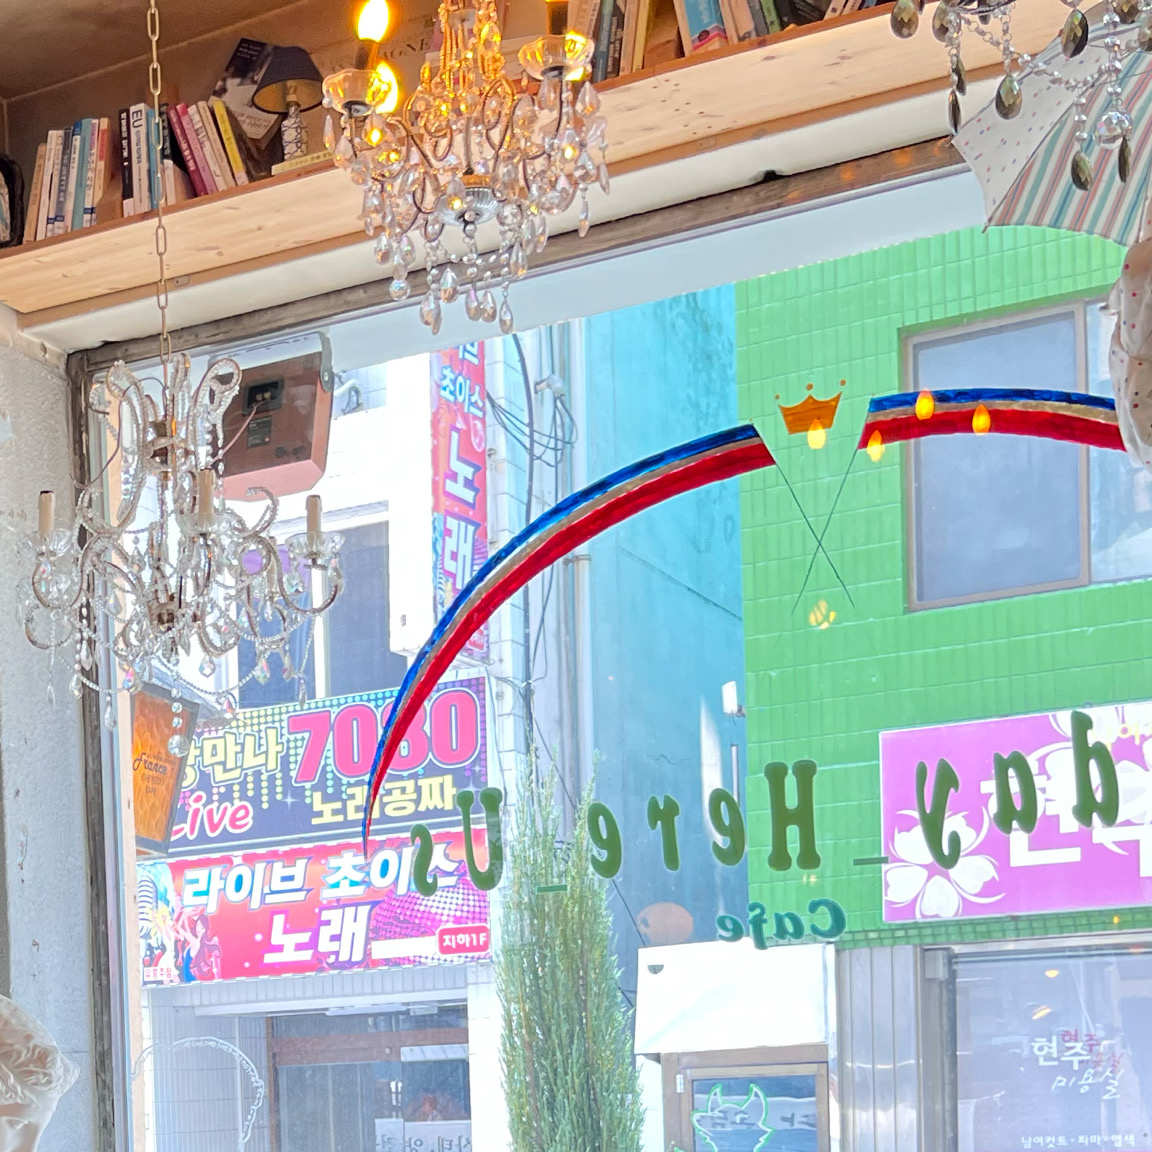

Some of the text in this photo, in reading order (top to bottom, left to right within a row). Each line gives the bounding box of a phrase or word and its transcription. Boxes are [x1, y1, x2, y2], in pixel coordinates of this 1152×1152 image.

[440, 366, 484, 418] 초이스
[445, 428, 482, 590] 노래
[312, 775, 456, 825] 노래공짜
[183, 842, 459, 914] 라이브 초이스
[264, 905, 372, 964] 노래
[442, 931, 487, 950] 지하1F
[1031, 1035, 1091, 1071] 현주
[1052, 1068, 1124, 1099] 미용실
